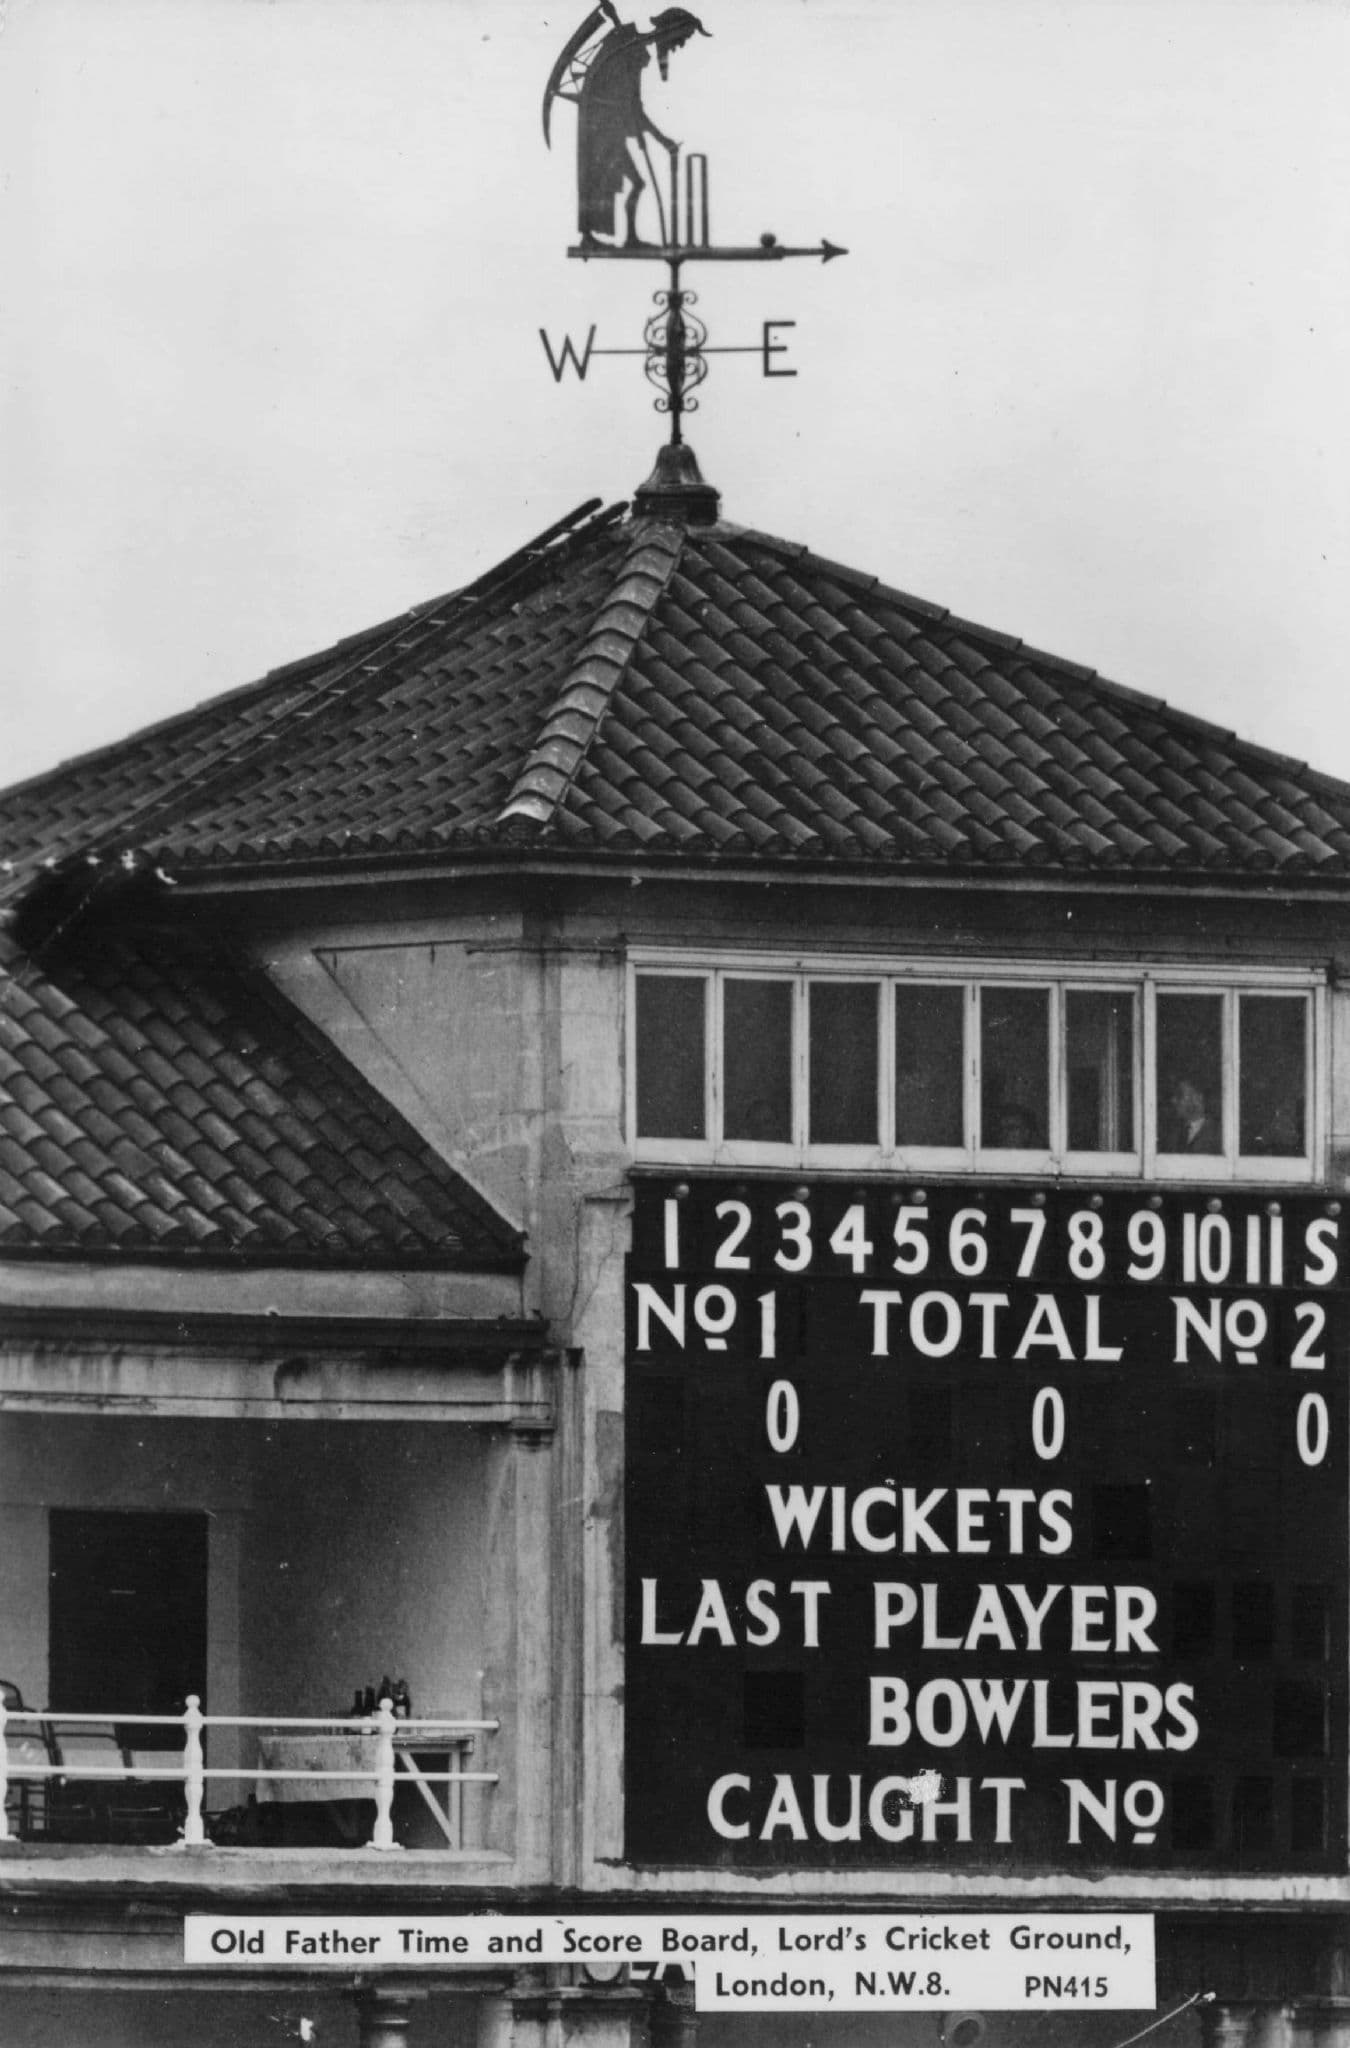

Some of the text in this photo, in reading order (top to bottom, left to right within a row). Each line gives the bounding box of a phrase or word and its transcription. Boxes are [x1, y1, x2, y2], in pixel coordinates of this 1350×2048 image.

[539, 323, 597, 383] W
[763, 320, 798, 378] E
[664, 1199, 1339, 1286] 1 2 3 4 5 6 7 8 9 10 11 S
[758, 1291, 776, 1359] 1
[860, 1290, 1123, 1361] TOTAL
[1291, 1302, 1326, 1370] 2
[767, 1380, 800, 1453] 0
[1032, 1387, 1065, 1460] 0
[1297, 1393, 1329, 1466] 0
[765, 1485, 1073, 1554] WICKETS
[641, 1578, 1158, 1652] LAST PLAYER
[869, 1676, 1199, 1752] BOWLERS
[707, 1773, 1025, 1844] CAUGHT
